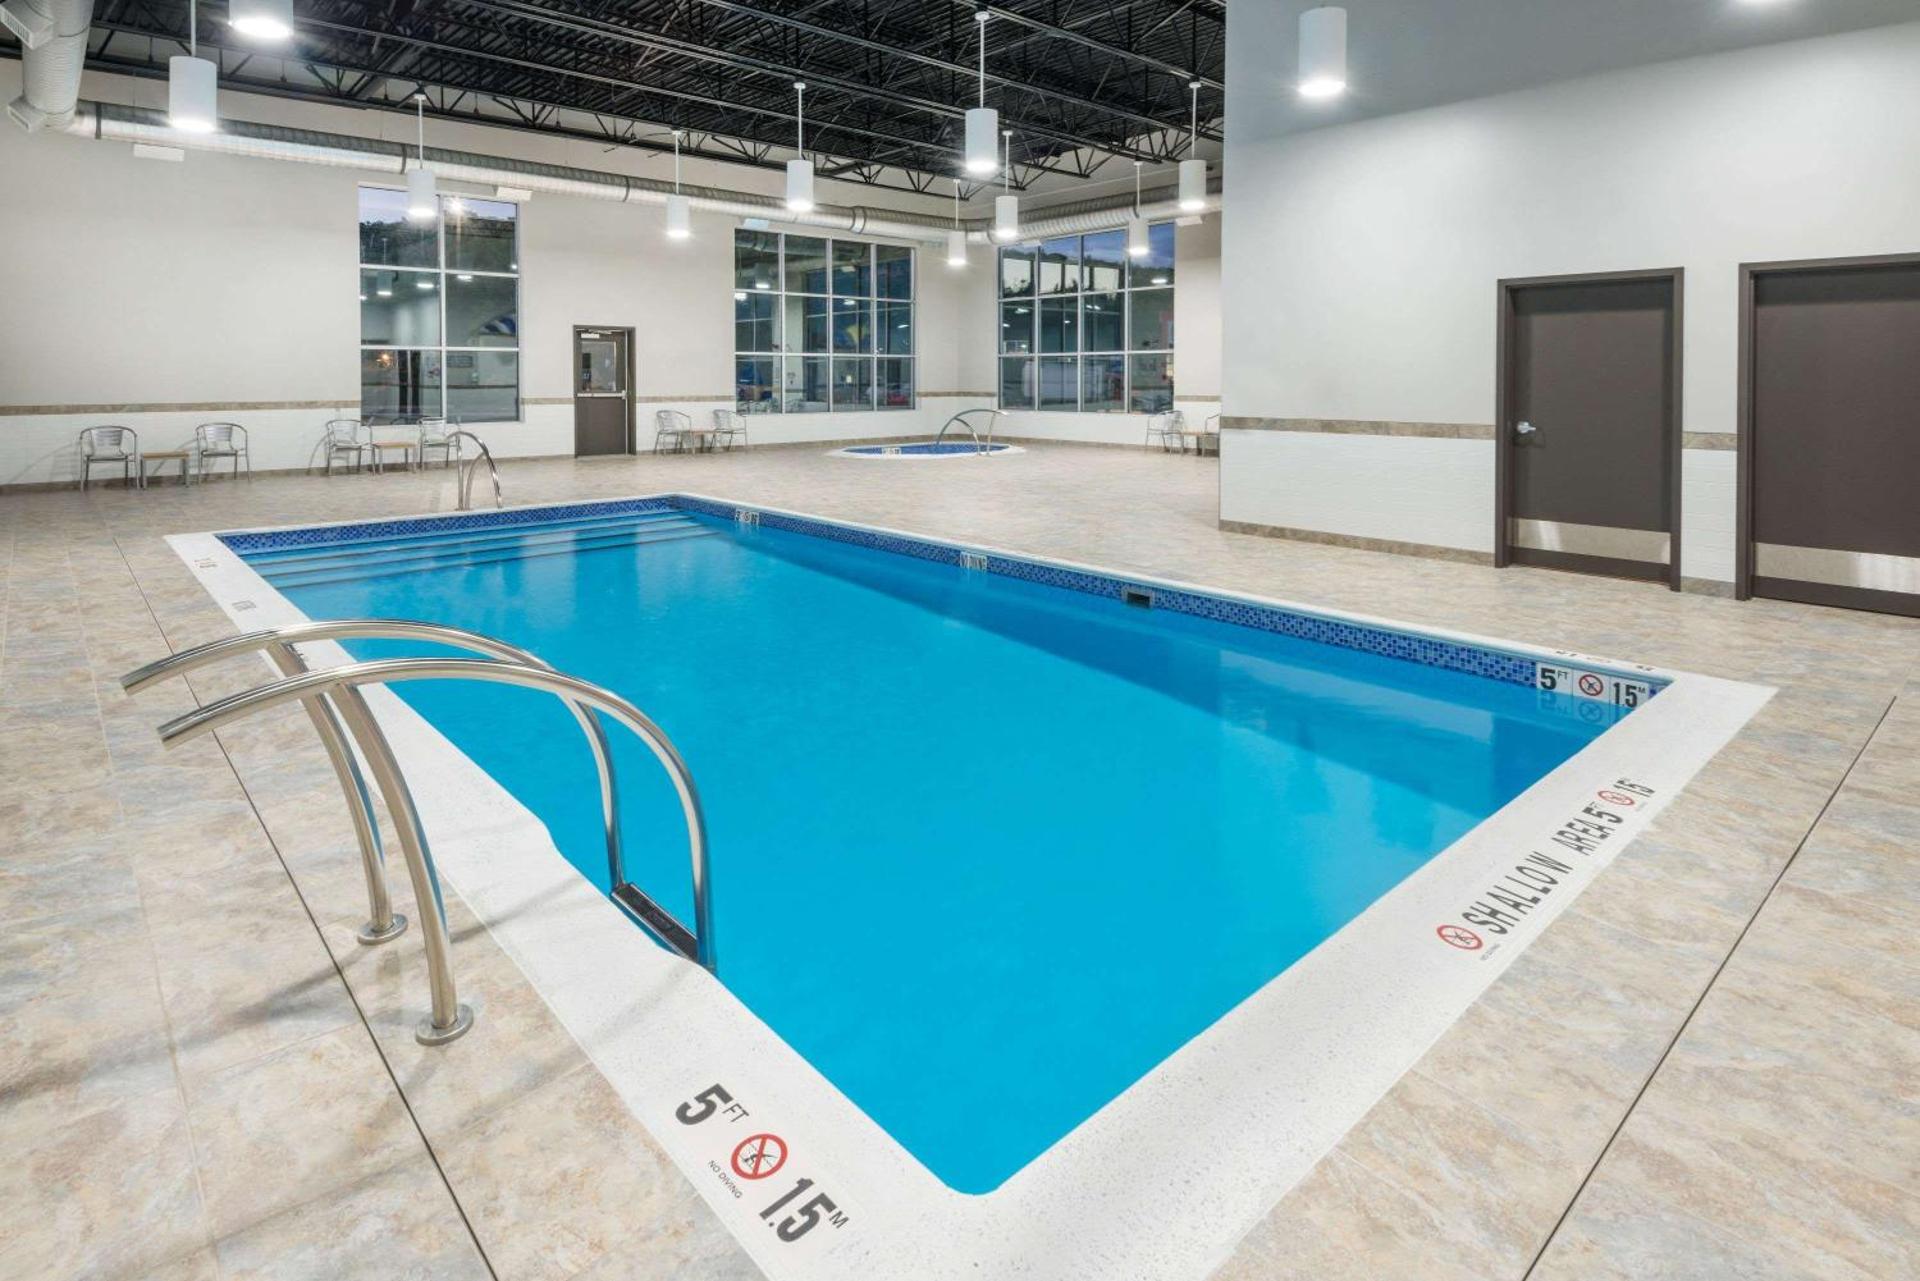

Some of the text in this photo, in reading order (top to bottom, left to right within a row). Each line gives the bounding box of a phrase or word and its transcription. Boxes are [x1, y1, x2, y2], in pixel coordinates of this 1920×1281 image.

[1462, 851, 1574, 935] SHALLOW
[1551, 818, 1616, 856] AREA
[708, 1160, 743, 1198] NO DIVING
